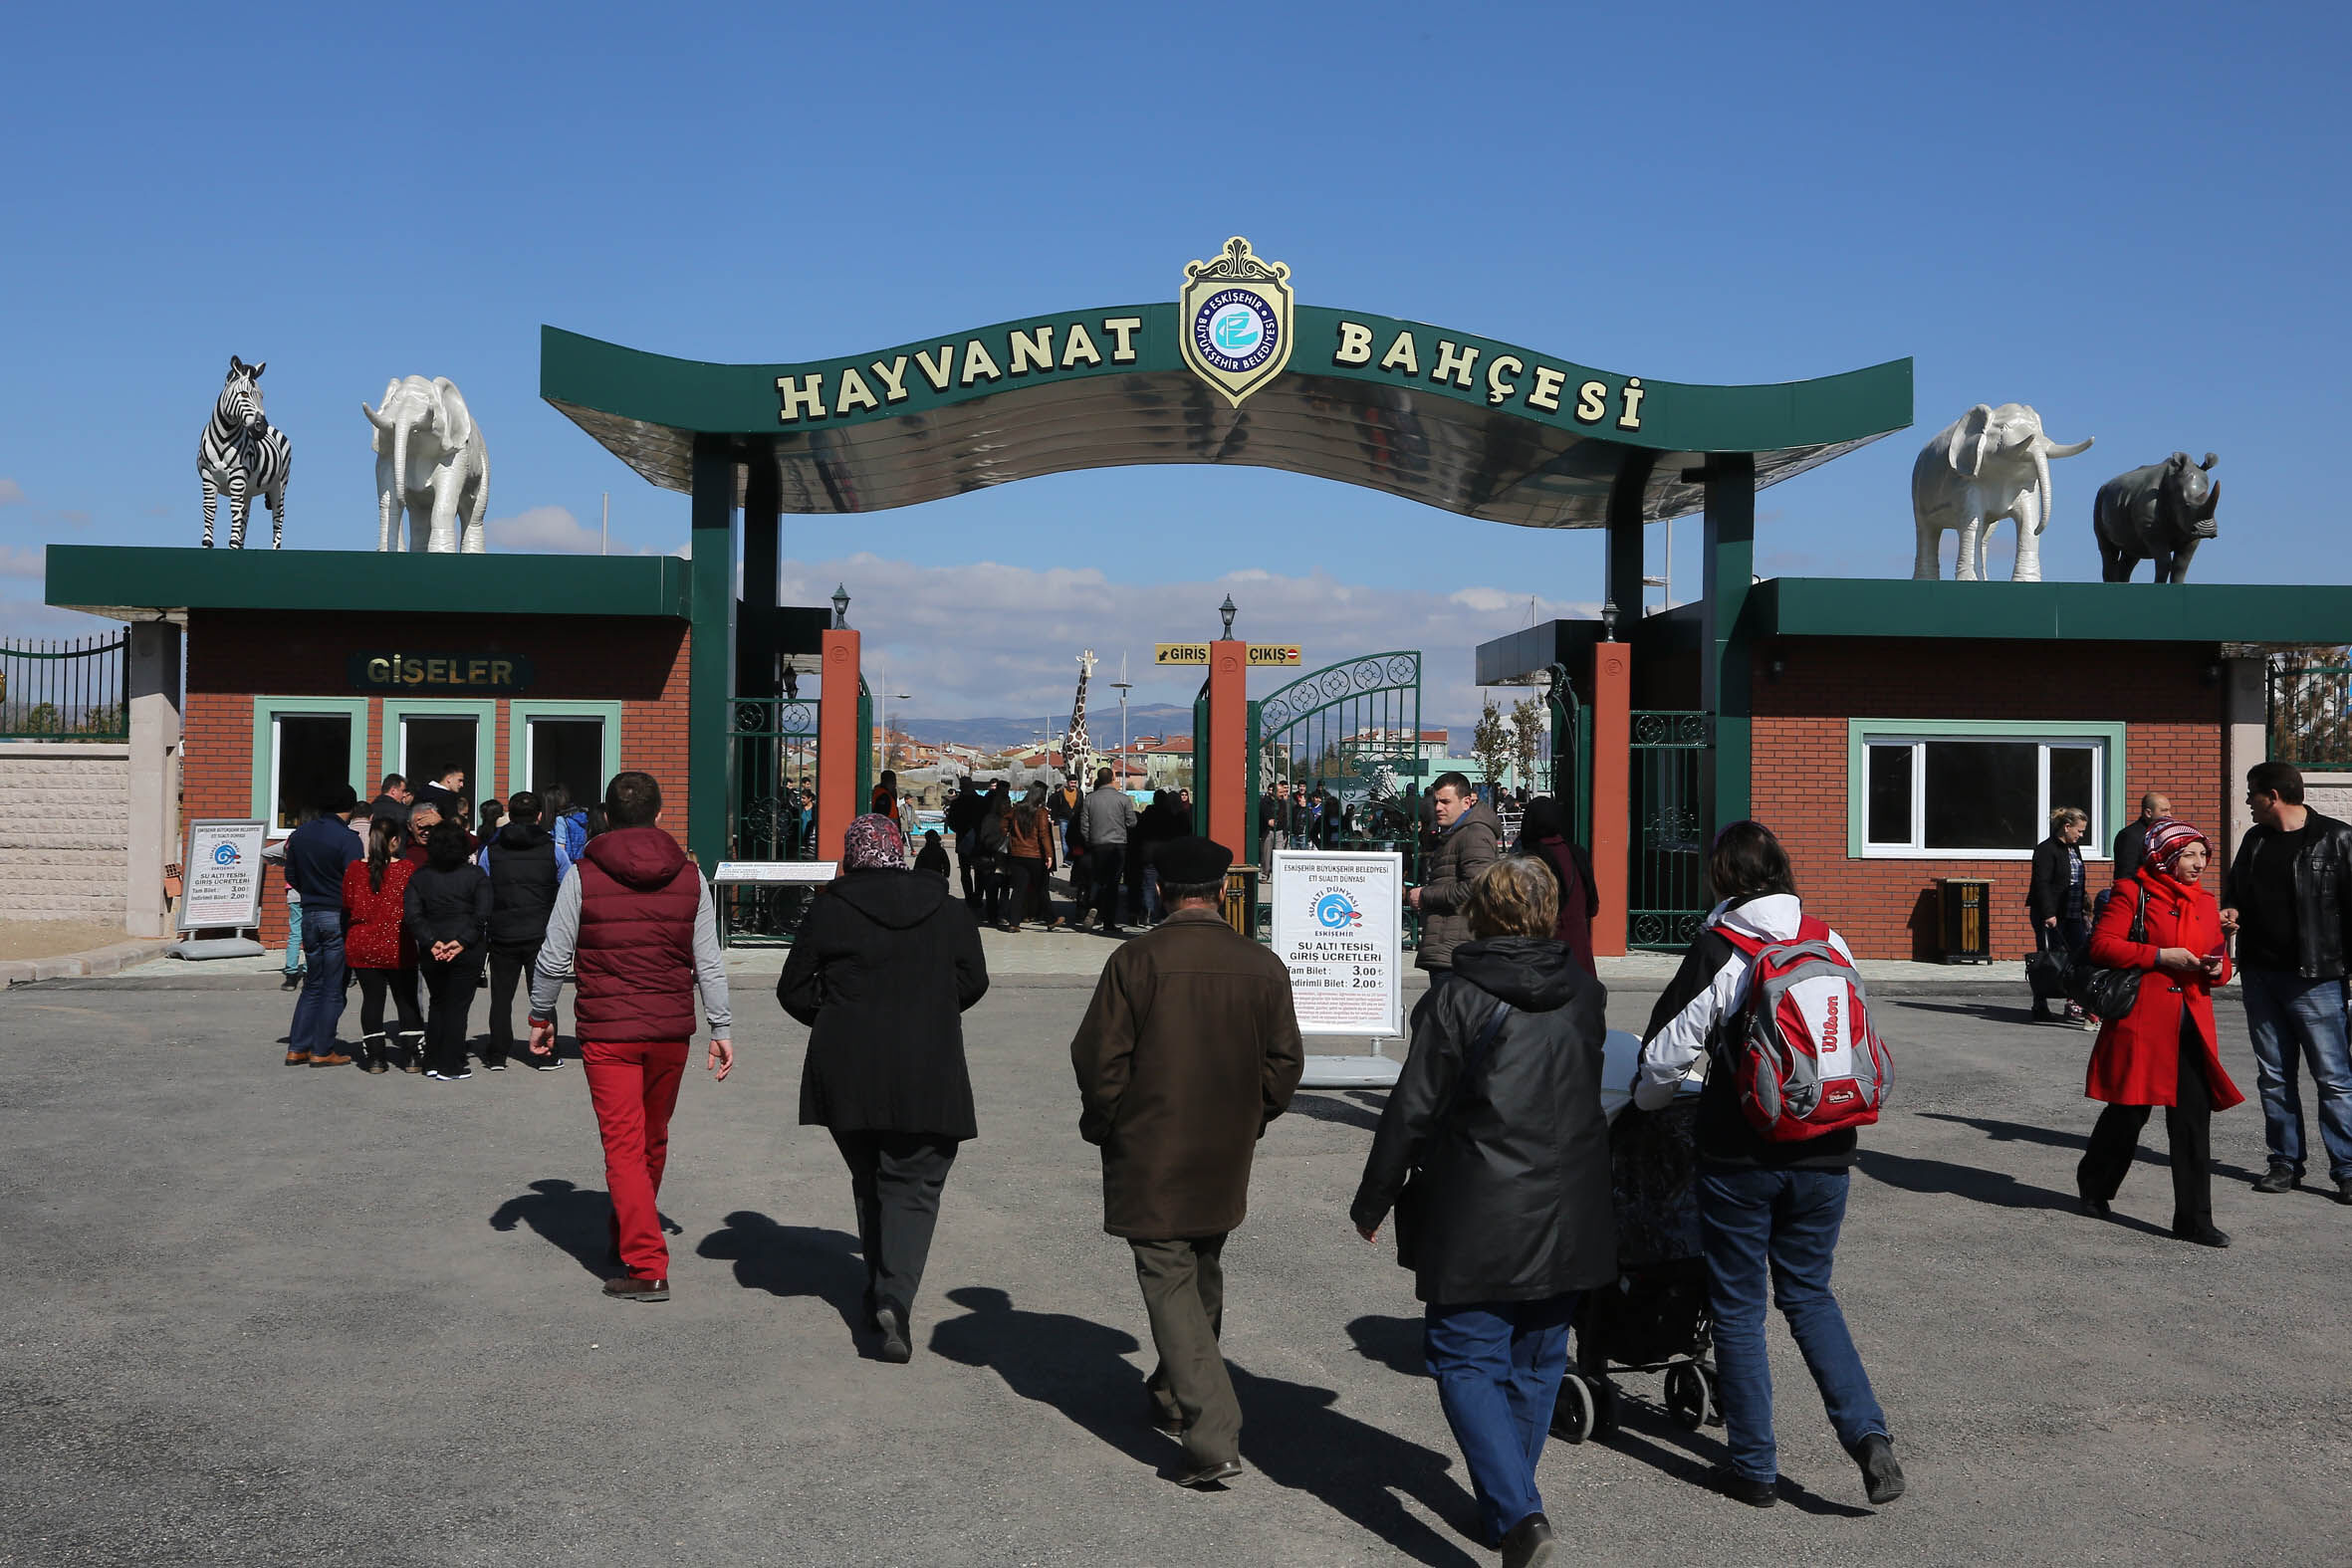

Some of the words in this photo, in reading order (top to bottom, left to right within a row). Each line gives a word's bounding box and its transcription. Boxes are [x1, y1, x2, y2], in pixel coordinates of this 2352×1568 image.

[1209, 291, 1263, 310] ESKİŞEHİR
[1197, 318, 1238, 369] BÜYÜKŞEHİR
[1243, 319, 1275, 368] BELEDİYESİ
[776, 317, 1141, 421] HAYVANAT
[1334, 321, 1644, 429] BAHÇESİ
[1170, 645, 1207, 663] GİRİŞ
[1249, 647, 1286, 664] ÇIKIŞ
[367, 653, 513, 687] GİŞELER
[1284, 863, 1315, 873] ESKİŞEHİR
[1308, 890, 1324, 918] SUALTI
[1326, 885, 1359, 907] DÜNYASI
[1314, 929, 1353, 938] ESKİŞEHİR
[1315, 942, 1337, 951] ALTI
[1290, 951, 1318, 963] GİRİŞ
[1322, 951, 1381, 962] ÜCRETLERİ
[1288, 966, 1304, 975] Tam
[1291, 979, 1322, 988] ndirimli
[1821, 996, 1838, 1053] Wilson
